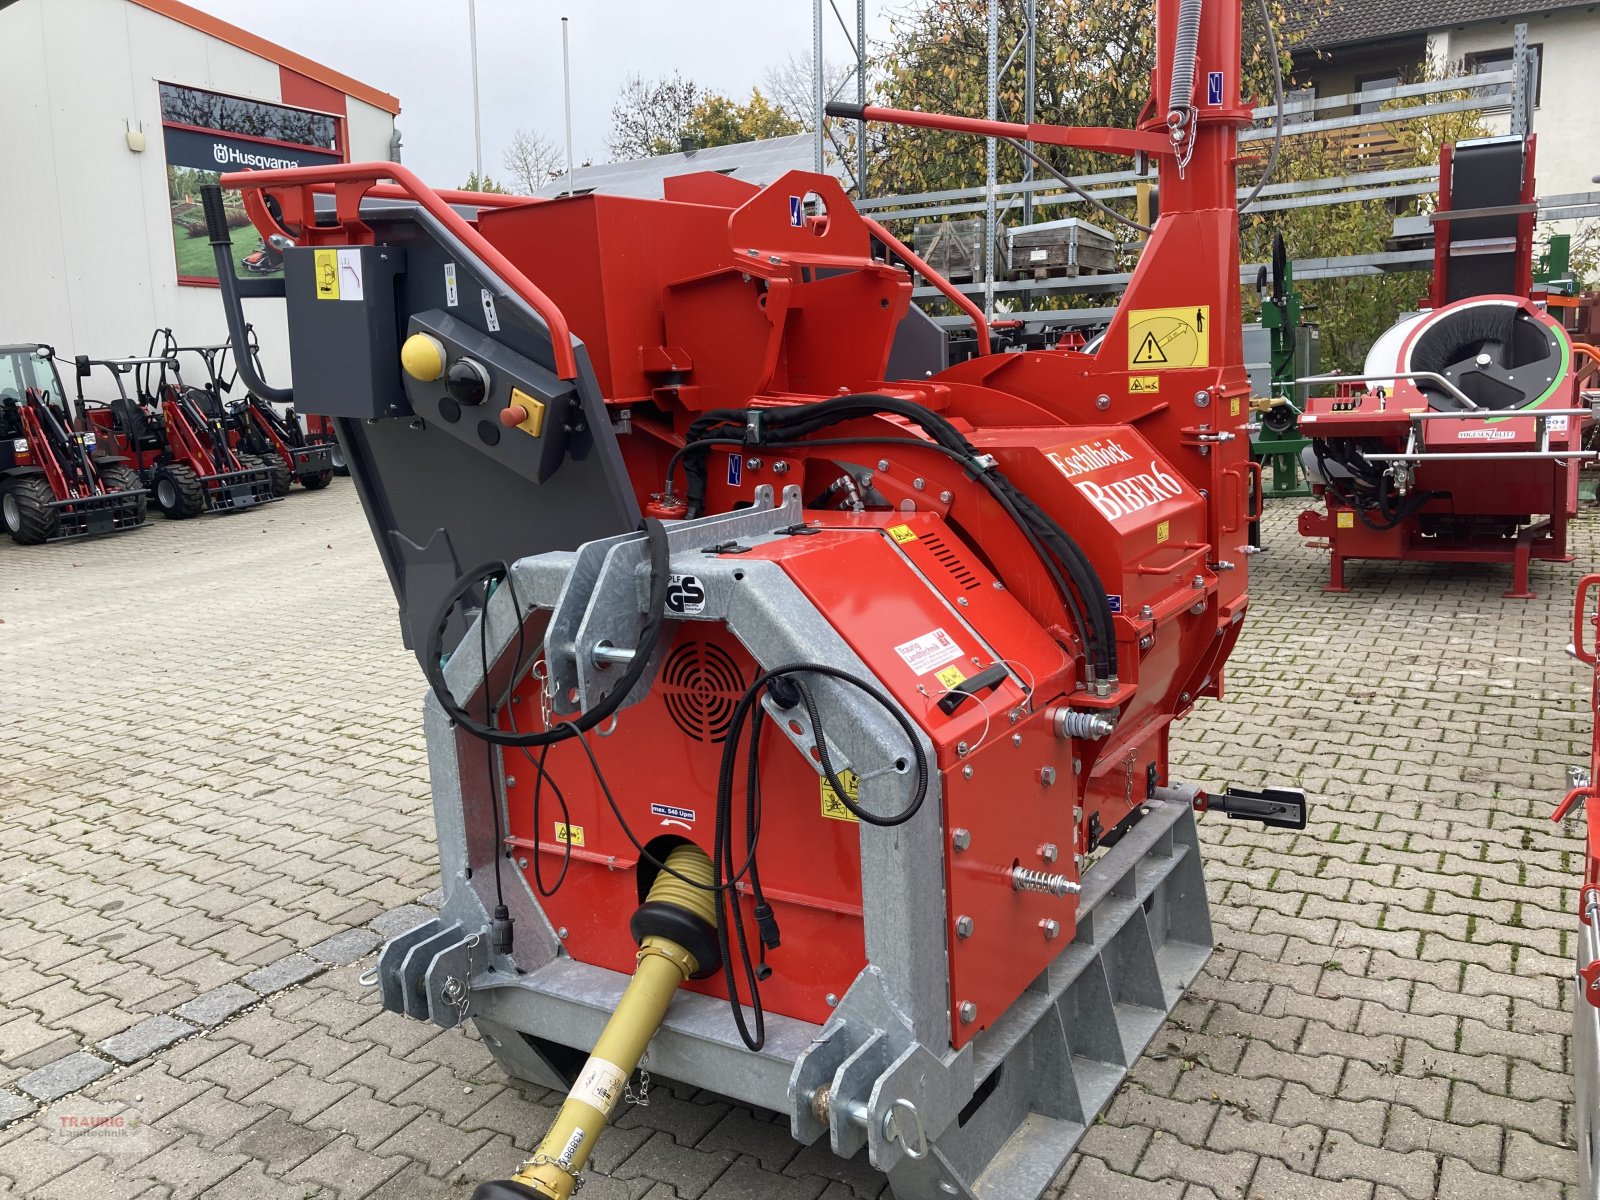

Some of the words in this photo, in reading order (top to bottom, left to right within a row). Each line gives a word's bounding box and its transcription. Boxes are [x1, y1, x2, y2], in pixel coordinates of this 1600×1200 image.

[229, 148, 299, 169] Husqvarna
[1045, 439, 1134, 478] Eschlböck
[665, 576, 704, 612] GS
